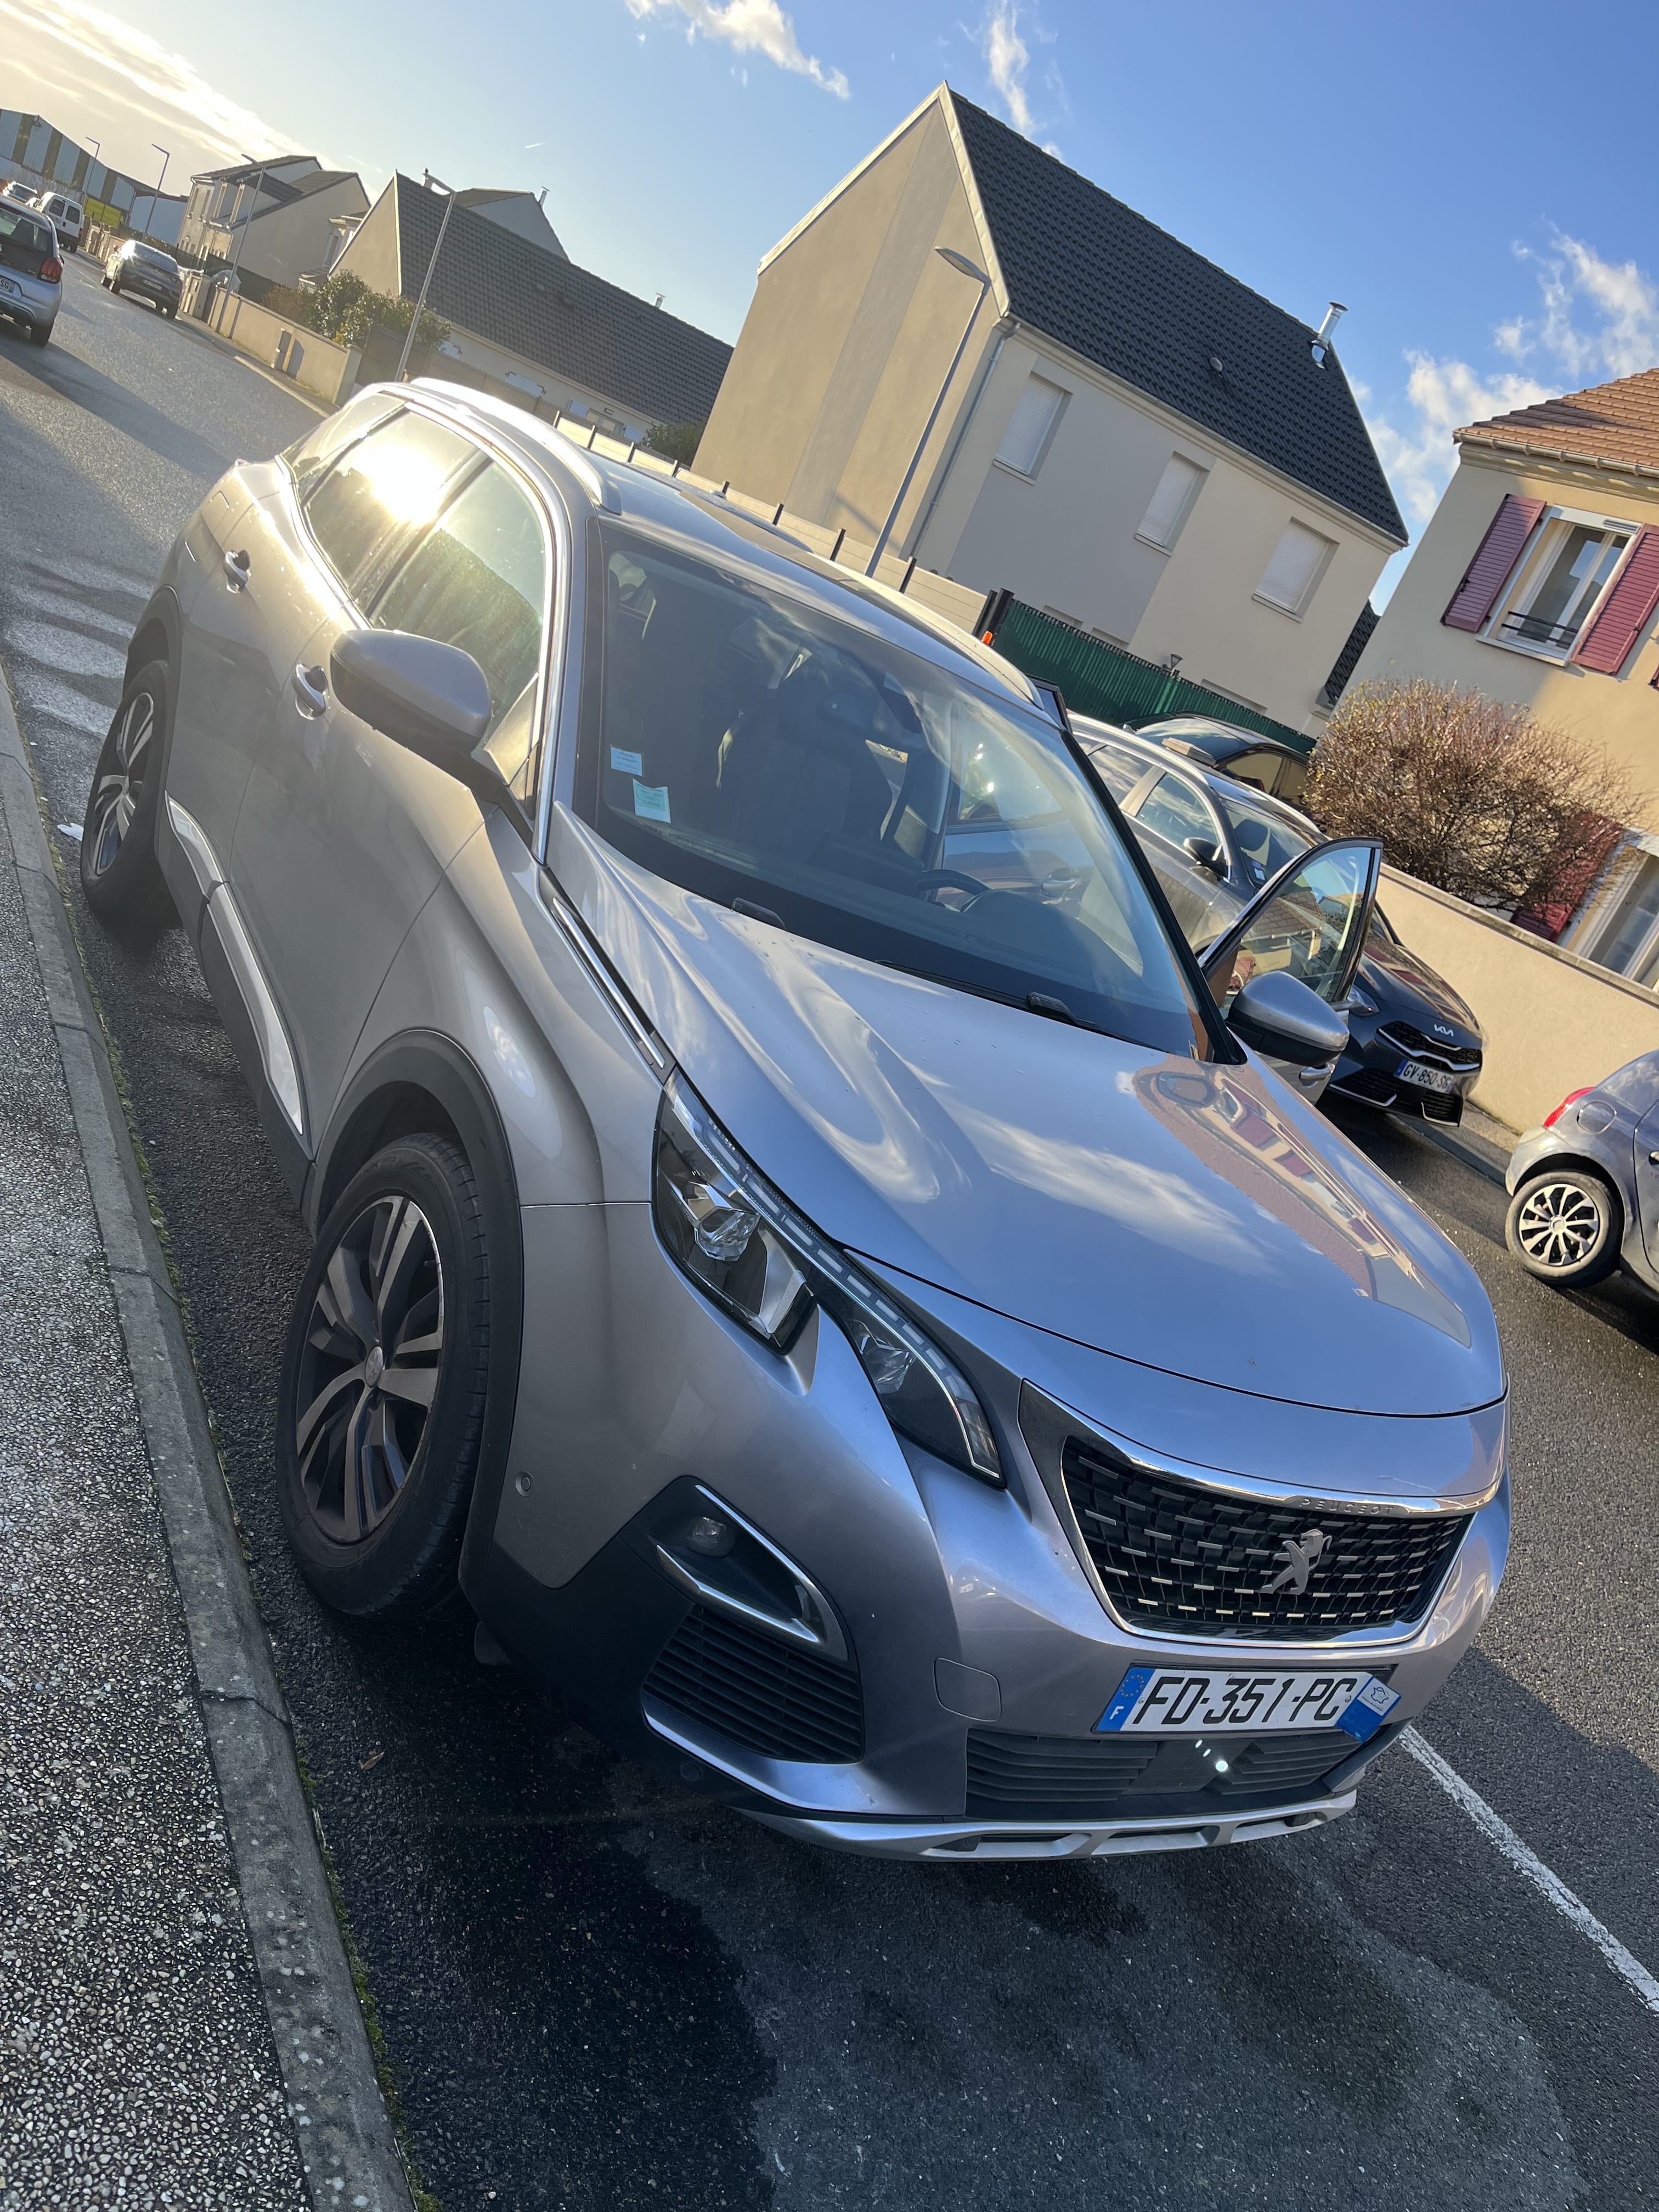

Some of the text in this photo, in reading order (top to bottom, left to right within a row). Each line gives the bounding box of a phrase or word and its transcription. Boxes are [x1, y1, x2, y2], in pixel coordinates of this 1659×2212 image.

[1299, 1497, 1394, 1516] PEUGEOT
[1133, 1676, 1357, 1725] FD-351-PC
[1109, 1706, 1124, 1720] F
